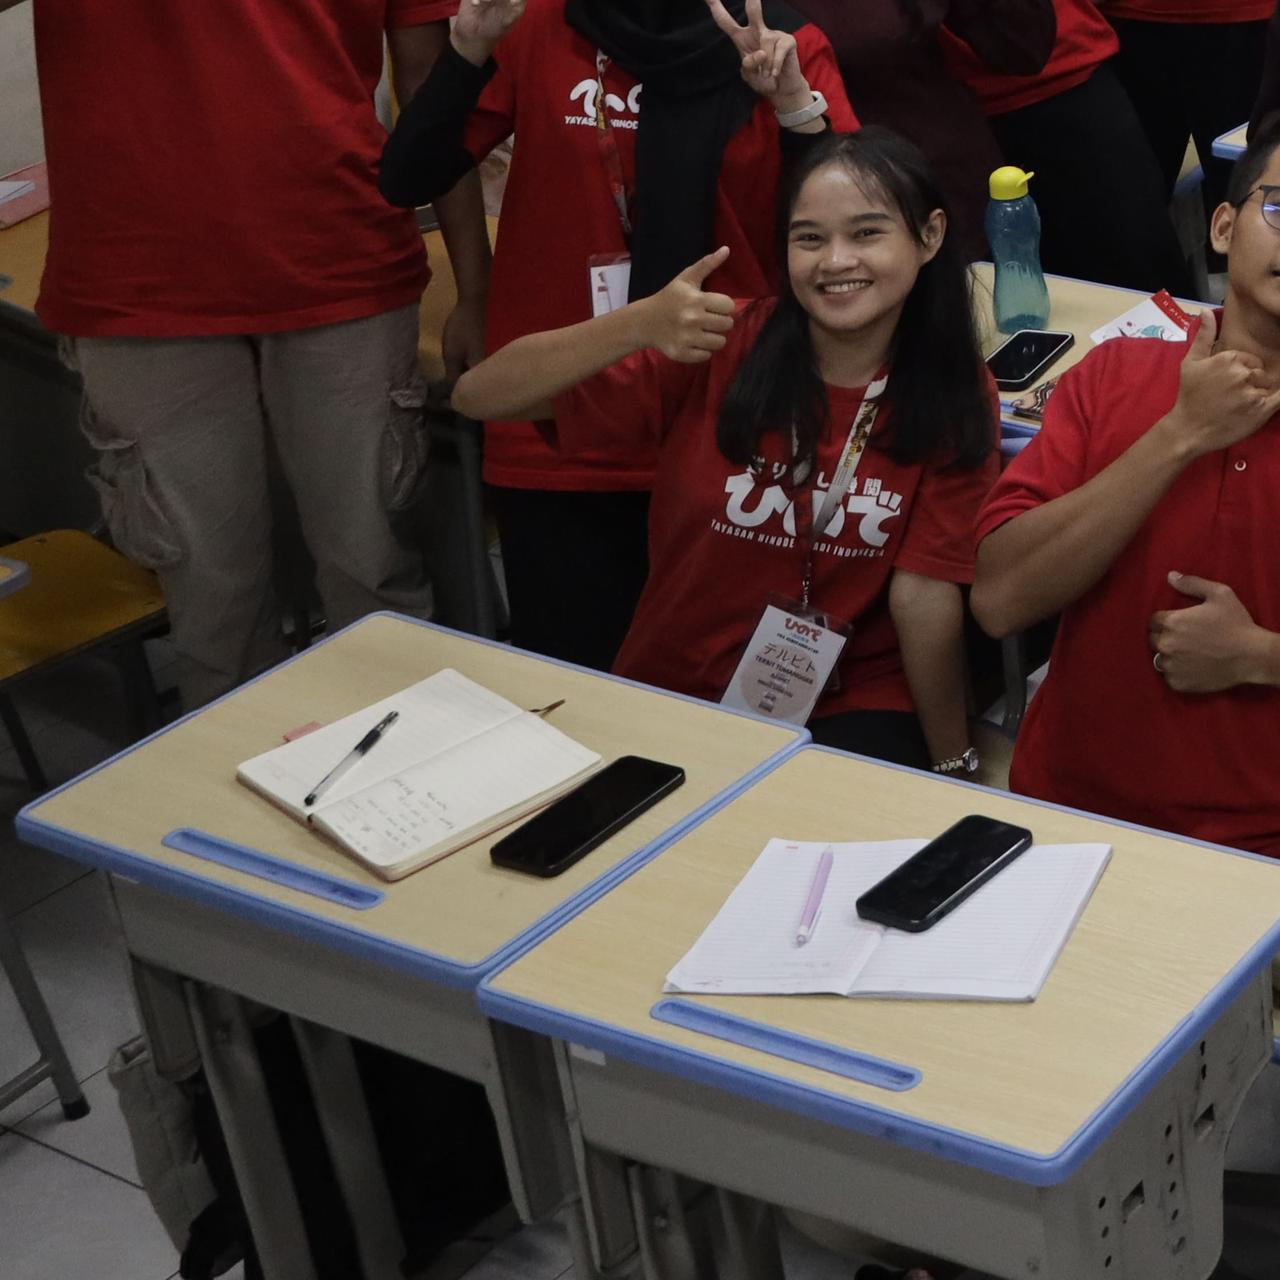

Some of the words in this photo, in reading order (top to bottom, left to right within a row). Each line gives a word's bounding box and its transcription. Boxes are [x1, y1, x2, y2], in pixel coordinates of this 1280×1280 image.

[710, 518, 755, 541] YAYASAN
[756, 534, 796, 549] HINODE
[784, 617, 823, 643] ひので
